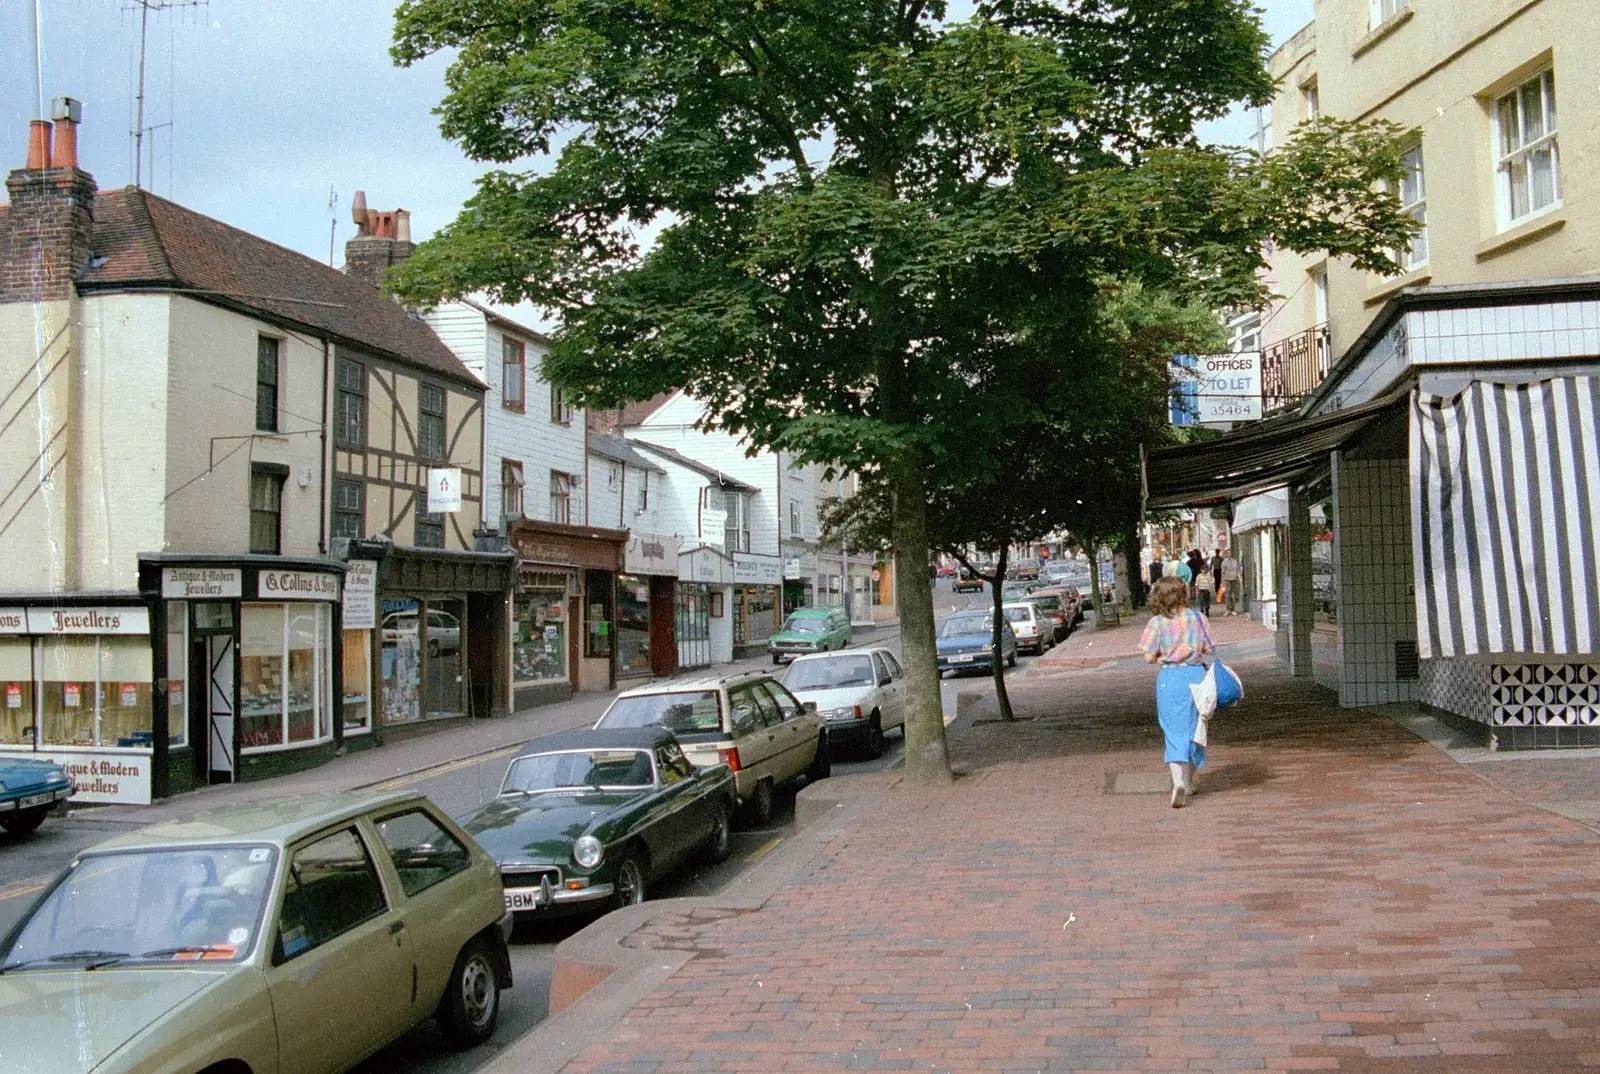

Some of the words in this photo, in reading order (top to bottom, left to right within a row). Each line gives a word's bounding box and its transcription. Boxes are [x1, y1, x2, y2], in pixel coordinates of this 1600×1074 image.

[1206, 359, 1252, 371] OFFICES
[1209, 378, 1227, 390] TO
[1231, 377, 1252, 390] LET
[1211, 405, 1251, 415] 35464
[169, 569, 200, 585] Antique
[201, 571, 206, 582] &
[207, 570, 235, 582] Modern
[266, 573, 279, 591] G.
[280, 572, 313, 592] Collins
[314, 575, 321, 592] &
[183, 581, 223, 597] Jewellers
[52, 610, 121, 632] Jewellers
[90, 760, 99, 774] &
[100, 760, 139, 776] Modern
